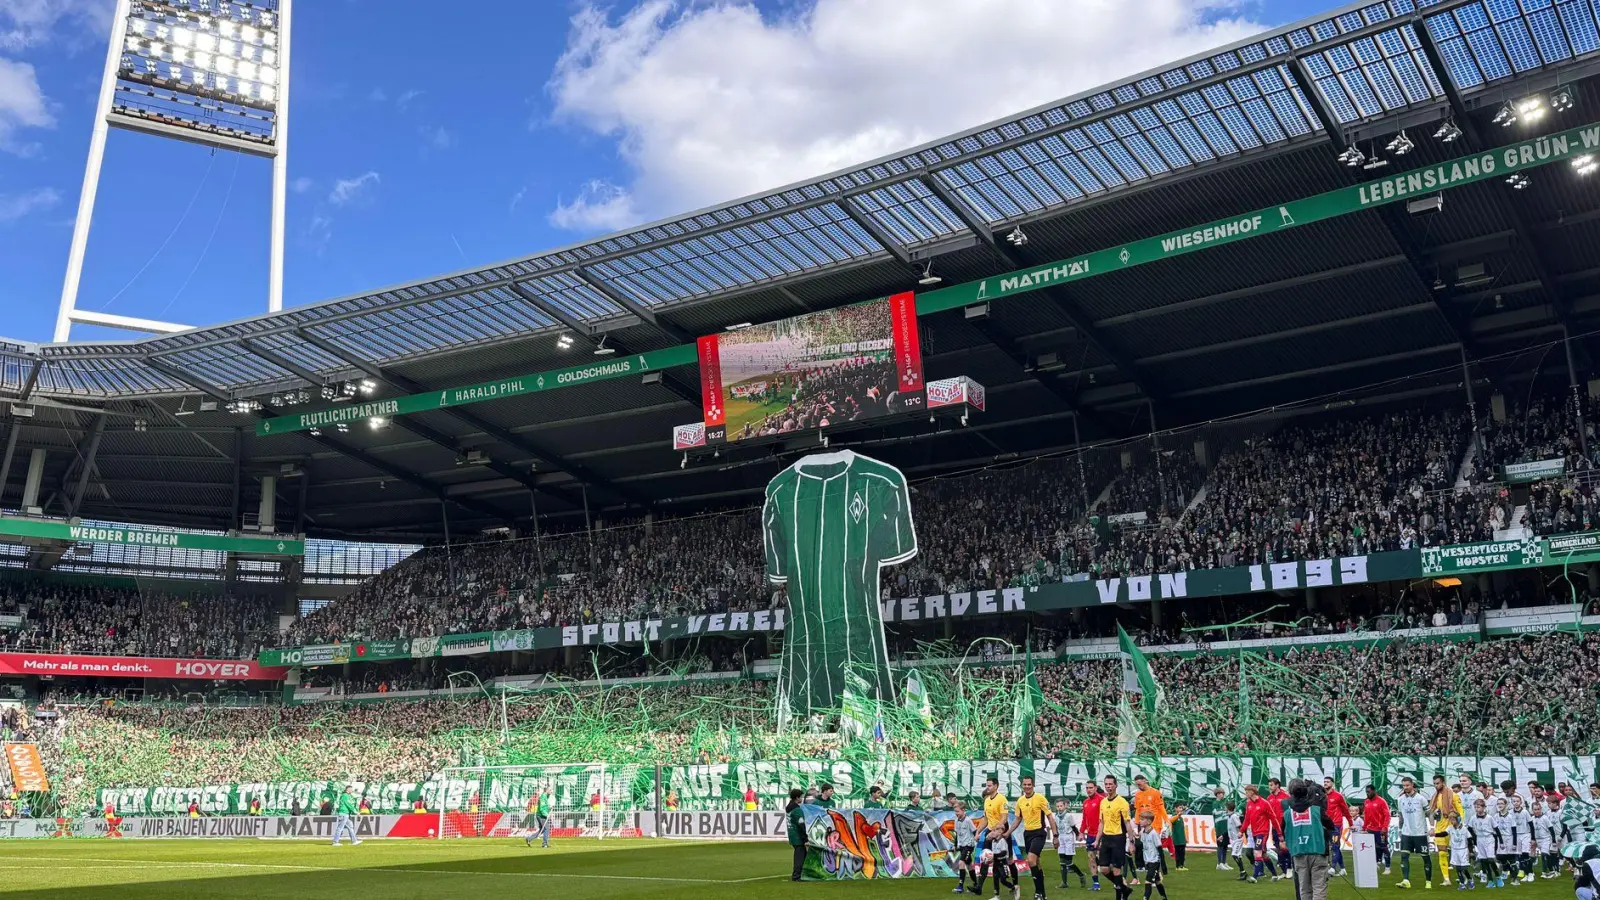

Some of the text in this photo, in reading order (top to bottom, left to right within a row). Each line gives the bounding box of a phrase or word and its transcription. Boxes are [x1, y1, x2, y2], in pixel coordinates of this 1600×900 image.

[1359, 155, 1496, 205] LEBENSLANG
[1161, 215, 1262, 252] WIESENHOF
[1000, 259, 1089, 292] MATTHÄI
[557, 360, 631, 384] GOLDSCHMAUS
[455, 380, 524, 402] HARALD PIHL
[300, 401, 399, 427] FLUTLICHTPARTNER
[708, 430, 724, 440] 15:27
[70, 526, 178, 546] WERDER BREMEN
[1441, 542, 1521, 558] WESERTIGERS
[1456, 554, 1508, 567] HOPSTEN
[1096, 571, 1187, 603] VON
[1249, 556, 1369, 591] 1899
[23, 659, 152, 672] Mehr als man denkt.
[176, 662, 250, 677] HOYER
[141, 818, 269, 836] WIR BAUEN ZUKUNFT
[277, 816, 380, 836] MATTÄI
[699, 812, 768, 836] BAUEN
[1298, 835, 1310, 845] 17
